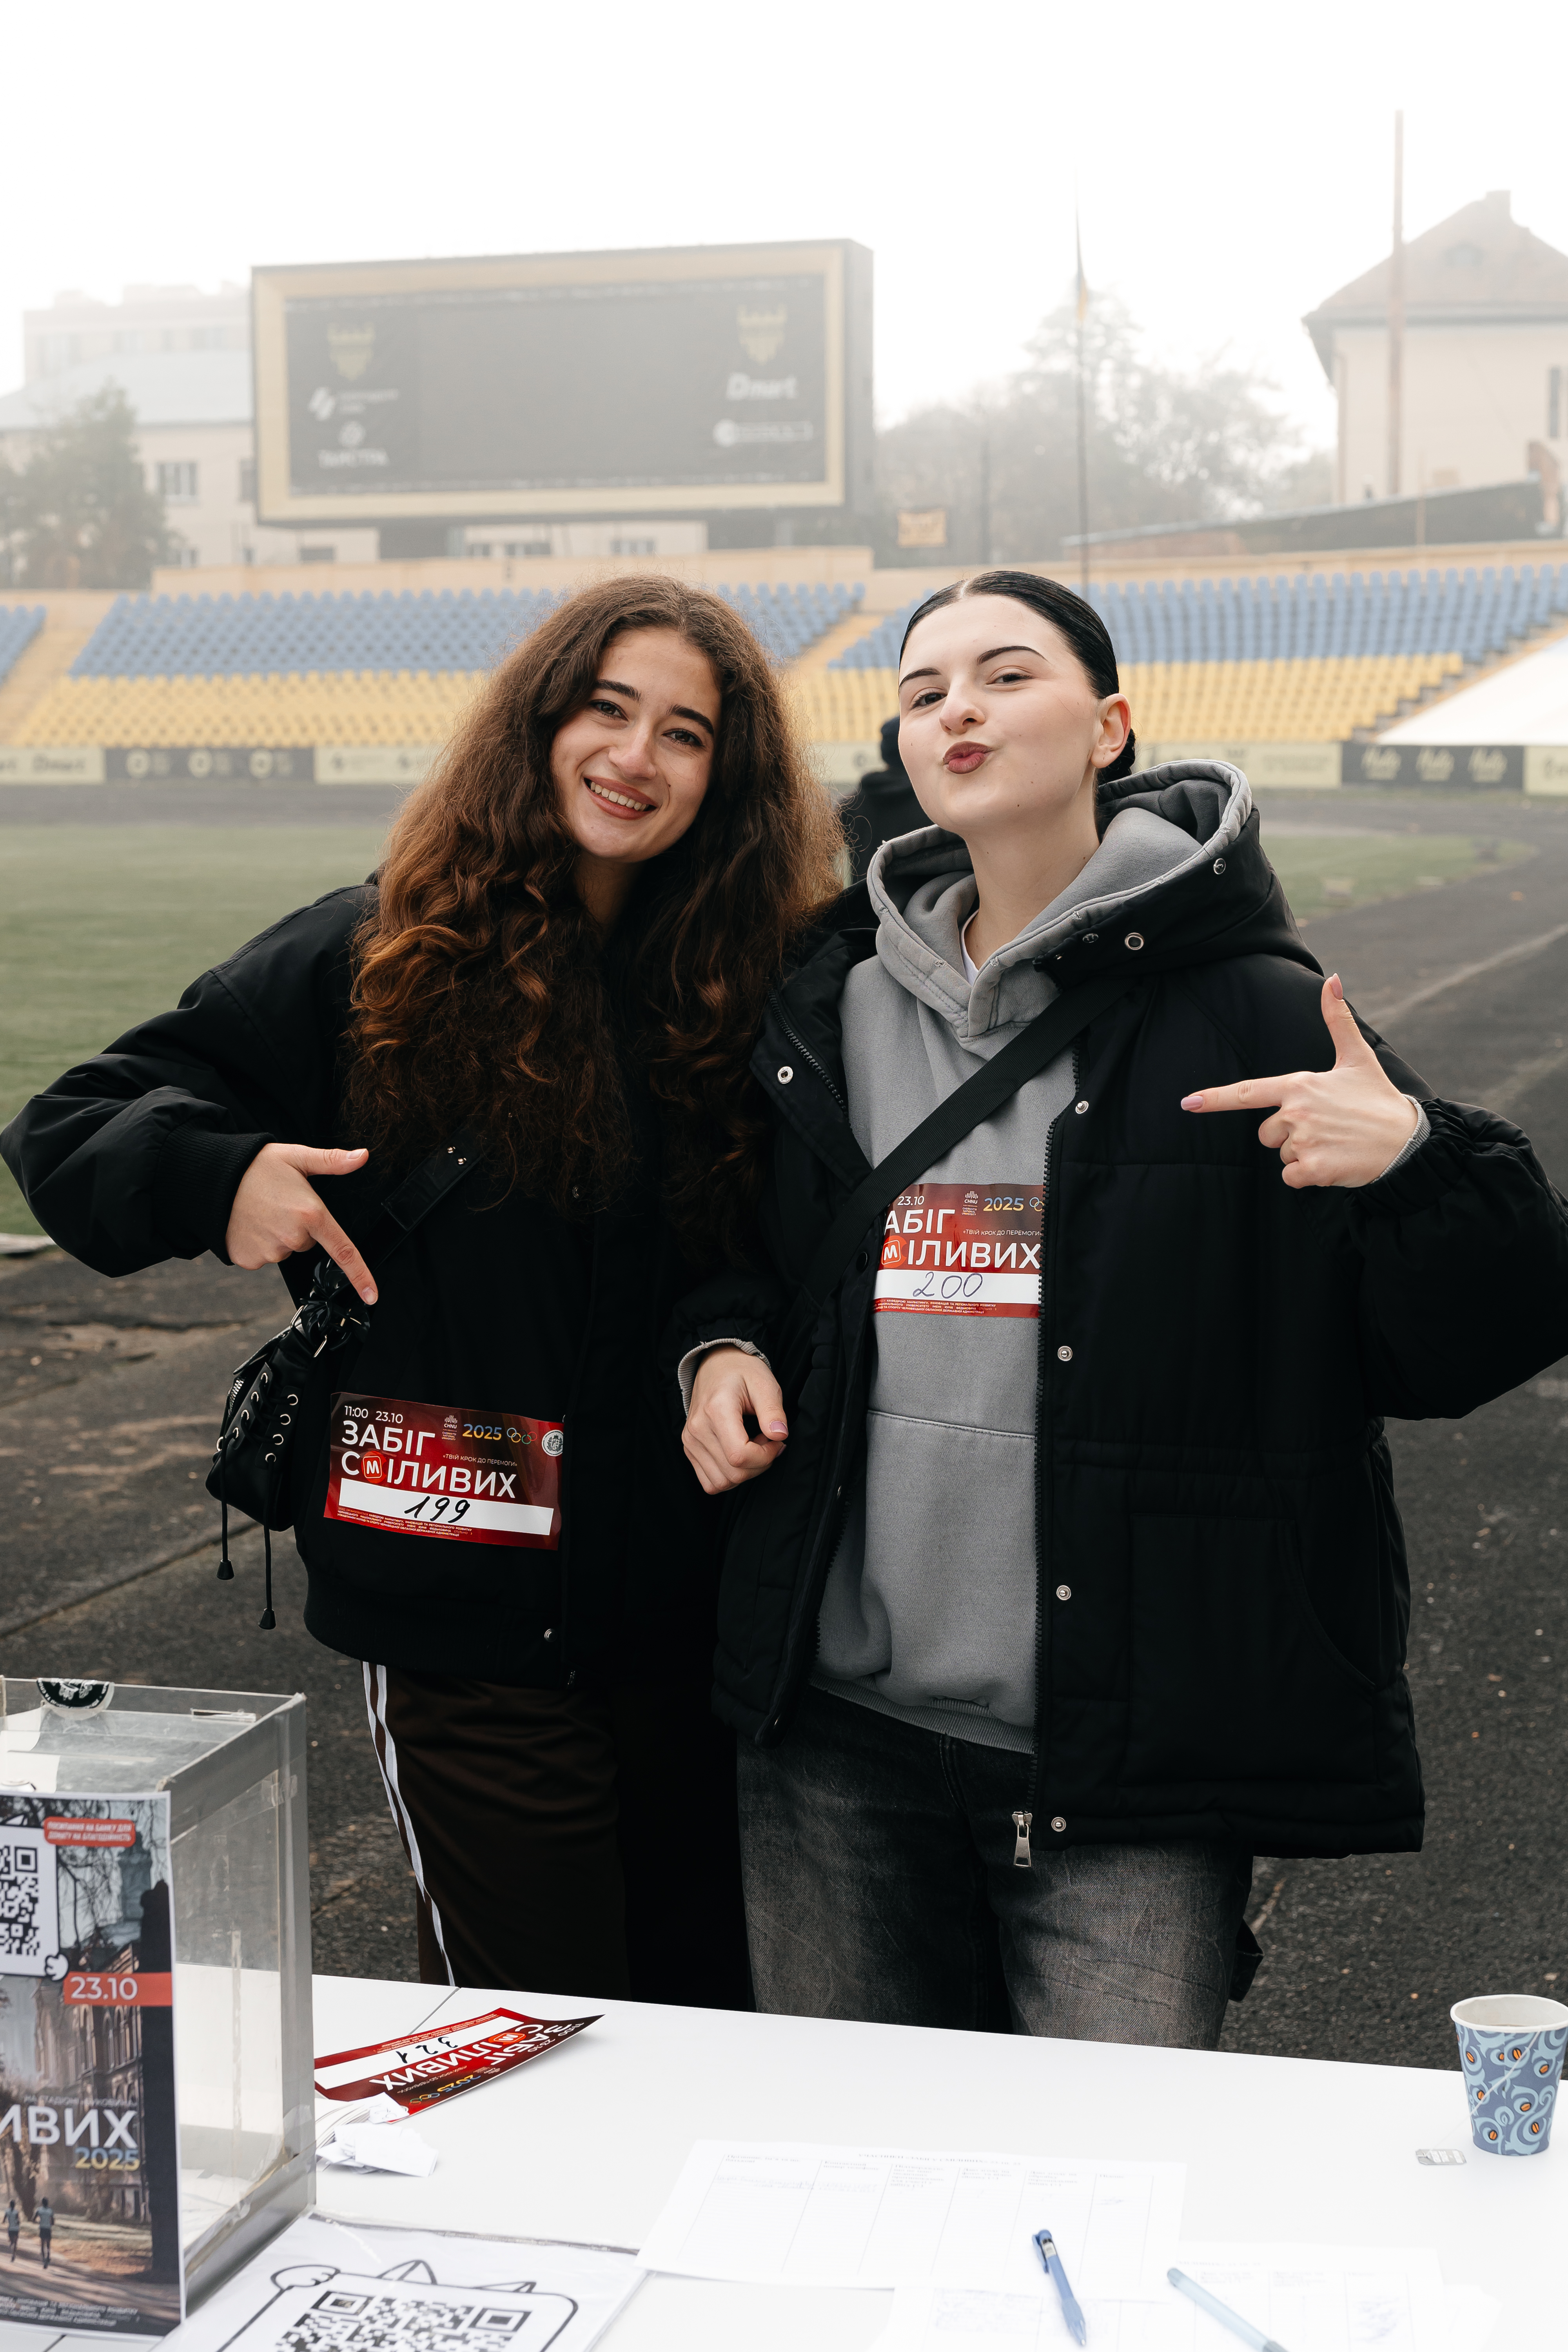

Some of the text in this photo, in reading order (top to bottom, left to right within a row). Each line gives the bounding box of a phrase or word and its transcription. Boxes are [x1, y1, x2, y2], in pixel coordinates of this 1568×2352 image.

[897, 1196, 924, 1206] 23.10
[983, 1197, 1024, 1211] 2025
[884, 1209, 955, 1236] АБІГ
[882, 1239, 1041, 1269] МІЛИВИХ
[913, 1271, 983, 1299] 200
[345, 1405, 403, 1424] 11:00 23.10
[342, 1421, 435, 1456] ЗАБІГ
[463, 1424, 502, 1440] 2025
[404, 1496, 470, 1523] 199
[70, 1977, 138, 2001] 23.10
[484, 2024, 572, 2065] ЗАБІГ
[437, 2074, 481, 2092] 2025
[0, 2104, 138, 2149] ИВИХ
[75, 2147, 140, 2171] 2025
